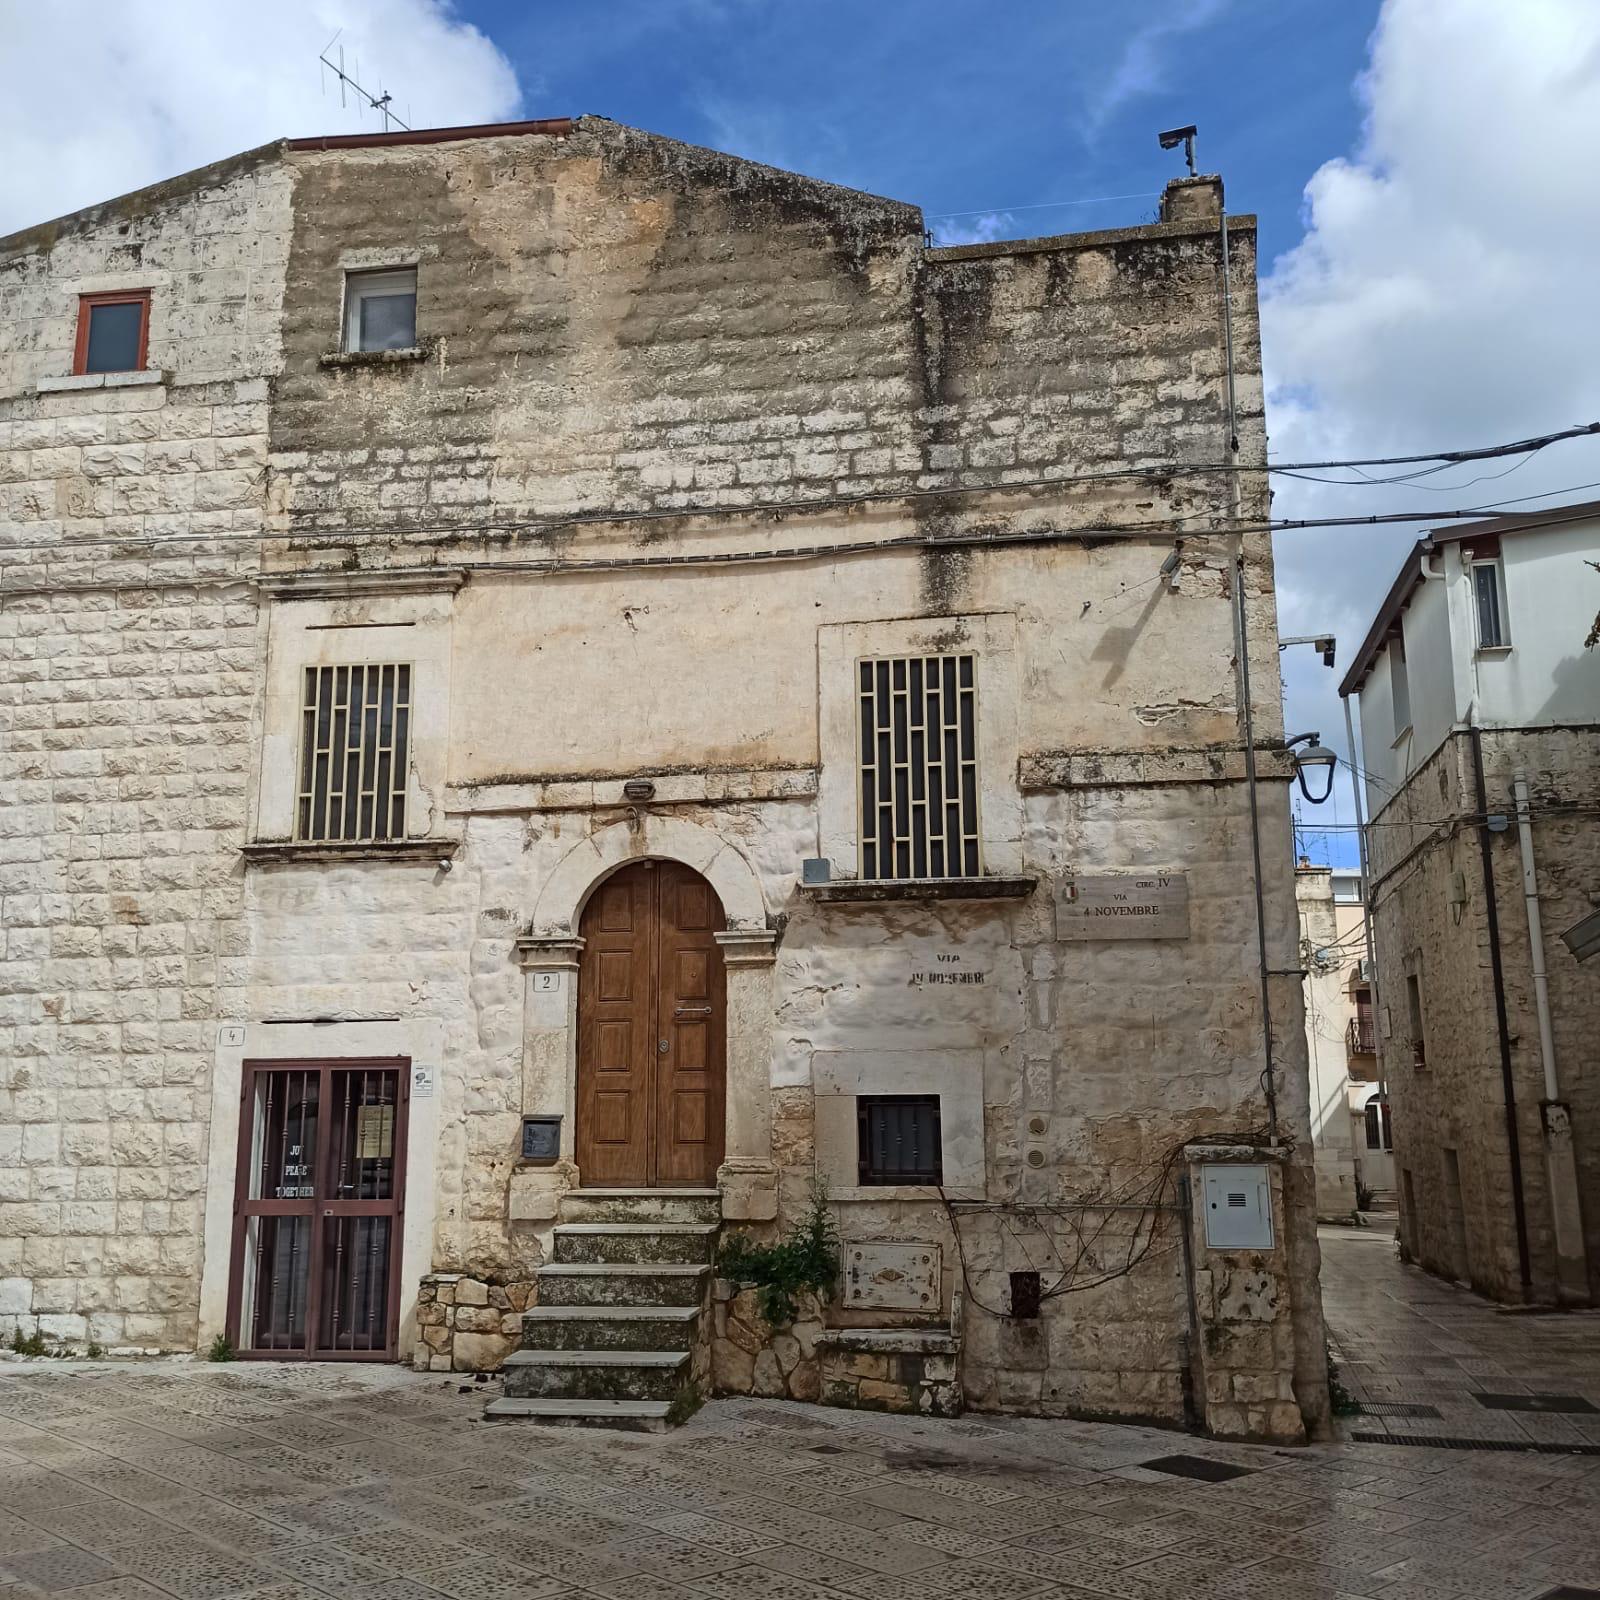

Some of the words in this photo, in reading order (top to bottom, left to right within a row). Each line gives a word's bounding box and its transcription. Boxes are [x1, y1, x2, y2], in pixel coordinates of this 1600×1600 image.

[1158, 878, 1170, 888] IV
[1083, 907, 1090, 916] 4
[1095, 905, 1159, 916] NOVEMBRE
[543, 975, 550, 988] 2
[229, 1030, 235, 1041] 4
[275, 1186, 314, 1197] TOGETHER
